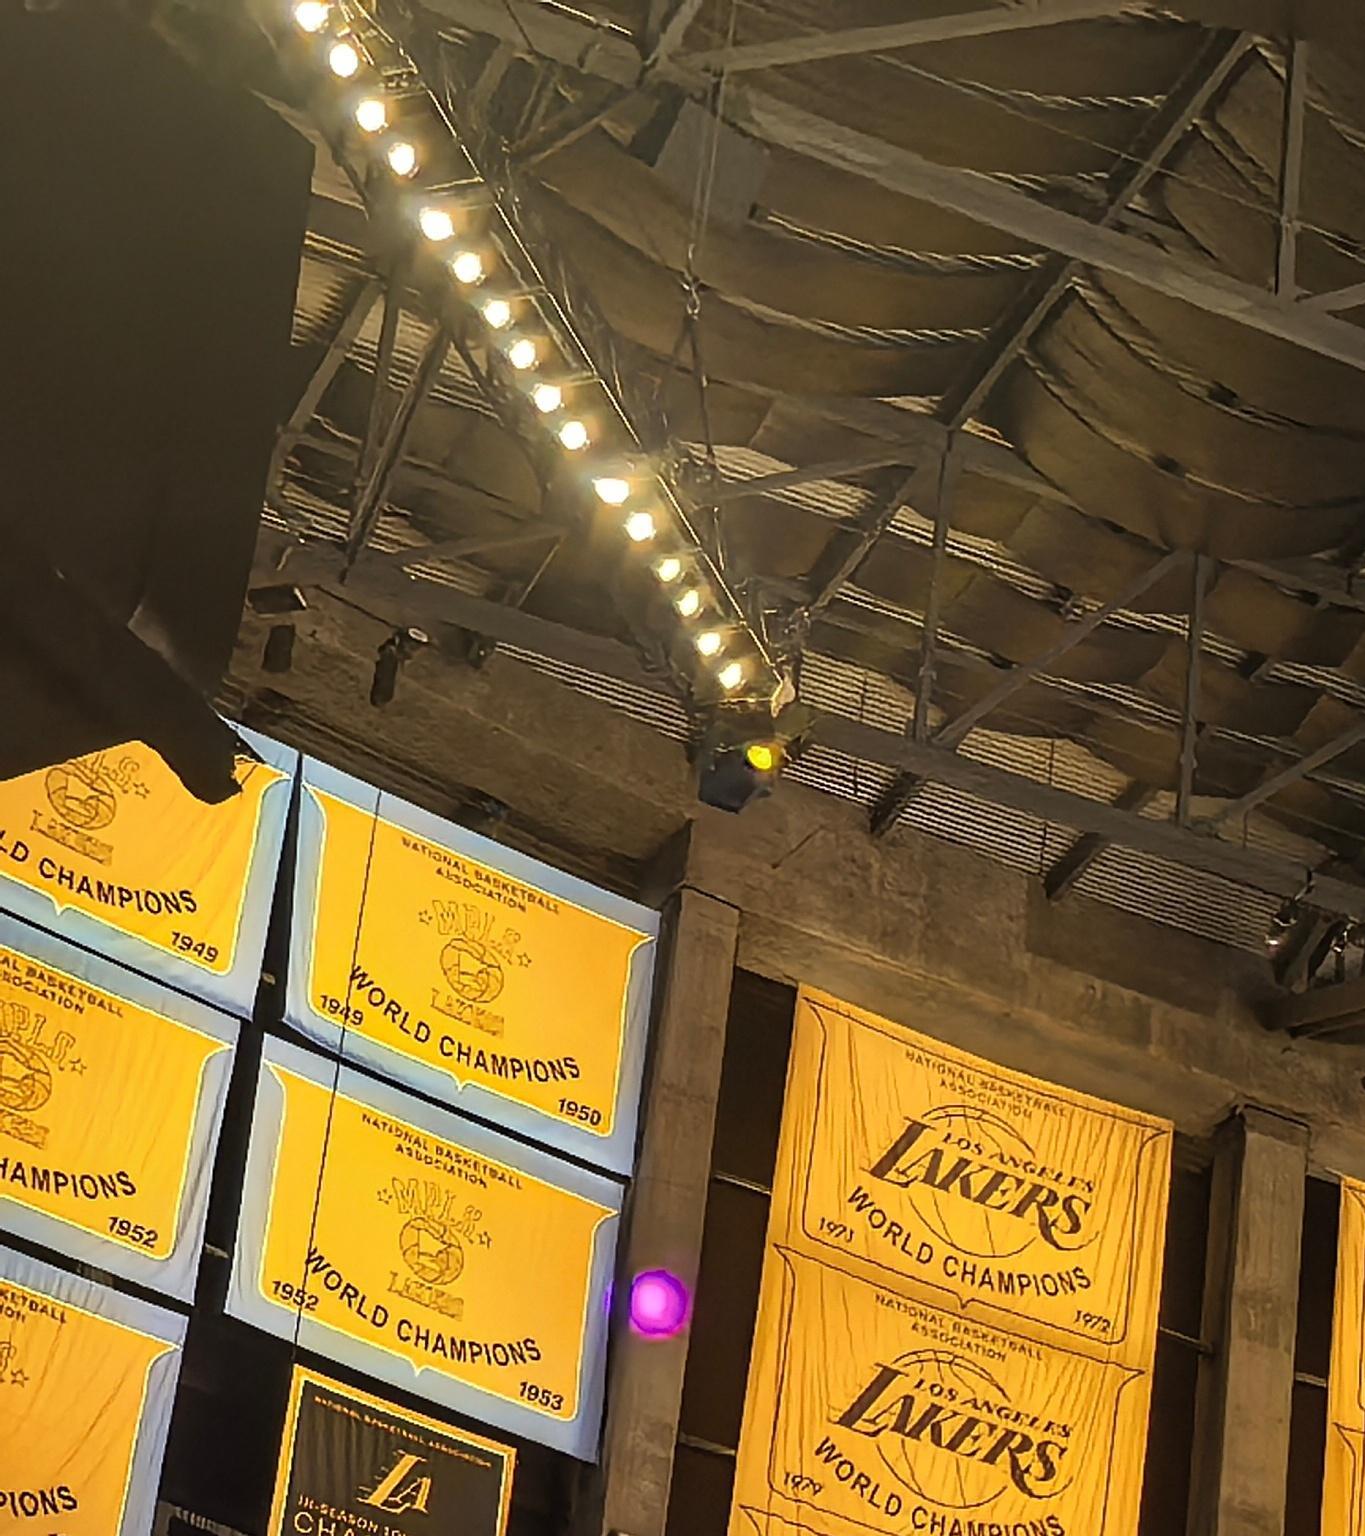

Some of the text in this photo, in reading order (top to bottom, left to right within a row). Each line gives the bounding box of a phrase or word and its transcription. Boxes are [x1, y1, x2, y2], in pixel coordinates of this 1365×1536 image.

[39, 857, 196, 914] CHAMPIONS
[171, 932, 218, 963] 1949
[319, 995, 363, 1026] 1949
[351, 966, 431, 1043] WORLD
[439, 1036, 580, 1082] CHAMPIONS
[558, 1098, 602, 1126] 1950
[860, 1116, 1100, 1251] LAKERS
[108, 1216, 158, 1248] 1952
[847, 1185, 1092, 1297] WORLD CHAMPIONS
[272, 1281, 319, 1311] 1952
[305, 1248, 388, 1328] WORLD
[397, 1319, 541, 1366] CHAMPIONS
[519, 1381, 564, 1411] 1953
[827, 1363, 1073, 1499] LAKERS
[814, 1436, 902, 1517] WORLD
